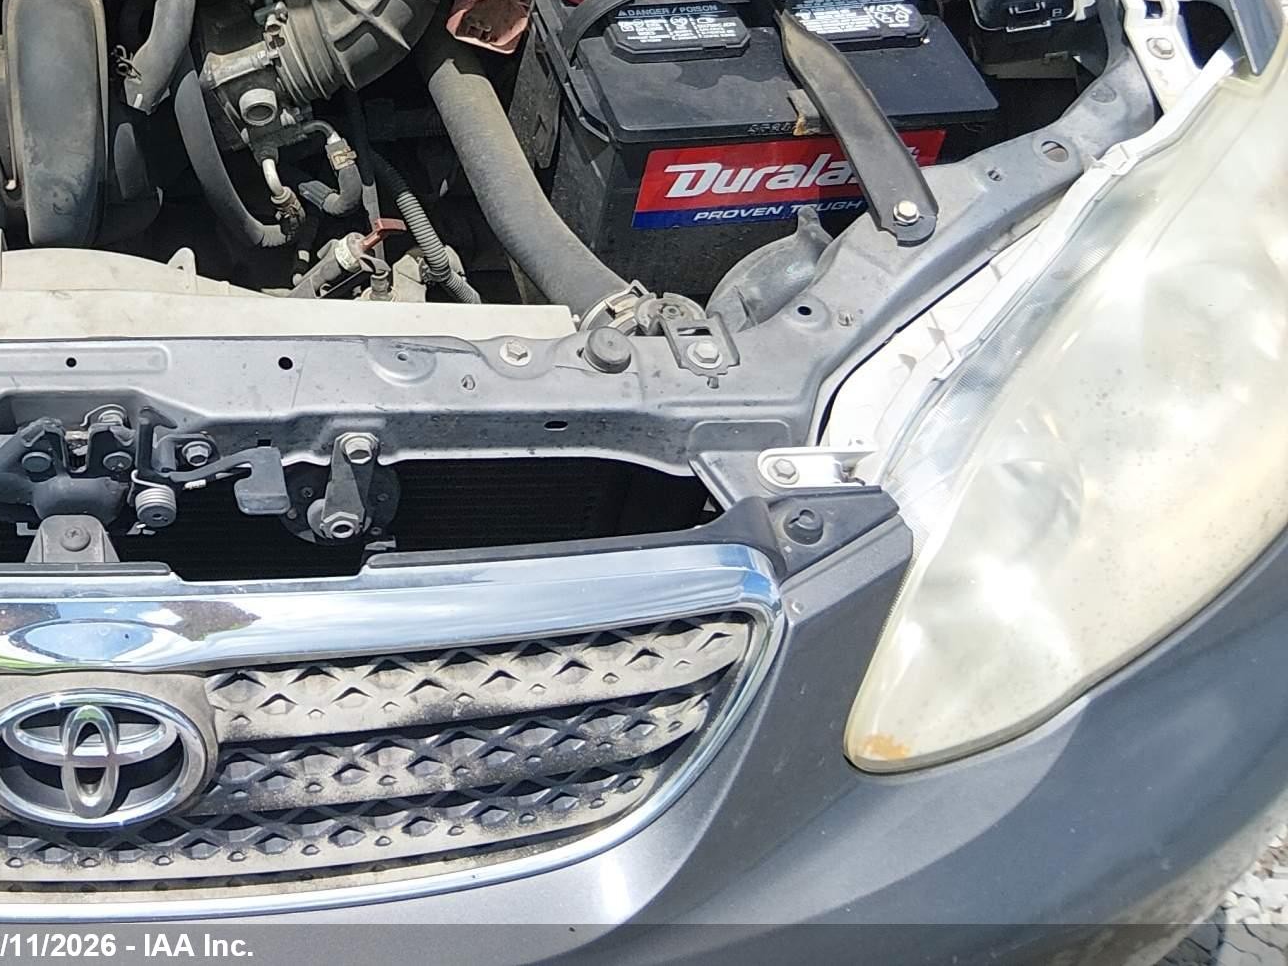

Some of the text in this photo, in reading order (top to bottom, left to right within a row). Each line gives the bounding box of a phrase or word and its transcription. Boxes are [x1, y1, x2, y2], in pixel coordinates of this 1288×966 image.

[626, 7, 671, 17] DANGER
[679, 4, 718, 14] POISON
[693, 200, 863, 221] PROVEN TUGH
